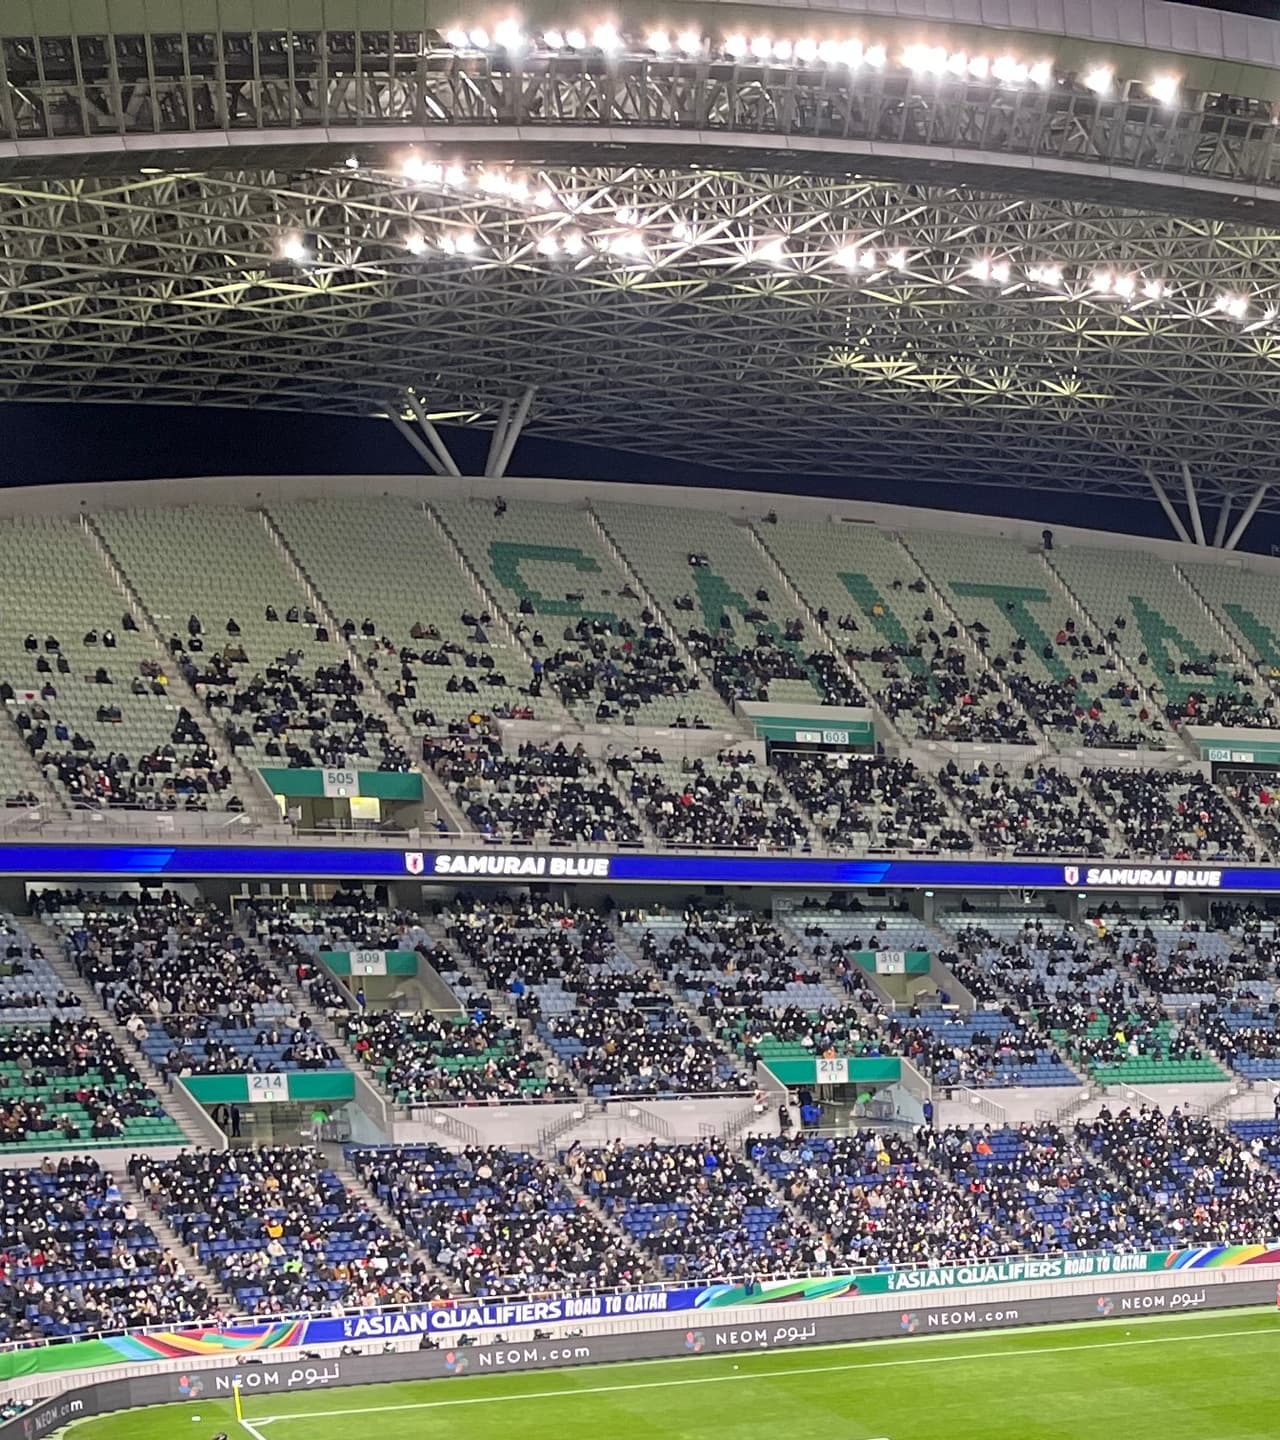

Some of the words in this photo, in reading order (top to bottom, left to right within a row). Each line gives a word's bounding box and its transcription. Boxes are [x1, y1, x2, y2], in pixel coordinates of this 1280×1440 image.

[824, 732, 848, 744] 603
[1209, 750, 1229, 761] 604
[327, 771, 355, 786] 505
[434, 854, 546, 875] SAMURAI
[550, 858, 609, 876] BLUE
[1086, 868, 1172, 885] SAMURAI
[1174, 870, 1222, 886] BLUE
[357, 951, 379, 964] 309
[881, 952, 901, 963] 310
[820, 1060, 844, 1072] 215
[253, 1074, 283, 1088] 214
[897, 1268, 954, 1290] ASIAN
[956, 1261, 1062, 1285] QUALIFIERS
[1064, 1256, 1093, 1273] ROAD
[1096, 1255, 1110, 1272] TO
[1113, 1254, 1148, 1271] QATAR
[1121, 1296, 1165, 1310] NEOM
[354, 1312, 428, 1337] ASIAN
[431, 1300, 562, 1330] QUALIFIERS
[565, 1297, 601, 1316] ROAD
[605, 1295, 621, 1313] TO
[625, 1292, 667, 1312] QATAR
[928, 1309, 1019, 1327] NEOM.com
[716, 1328, 767, 1346] NEOM
[479, 1346, 590, 1367] NEOM.com
[216, 1371, 279, 1391] NEOM
[34, 1400, 84, 1432] NEOM.com
